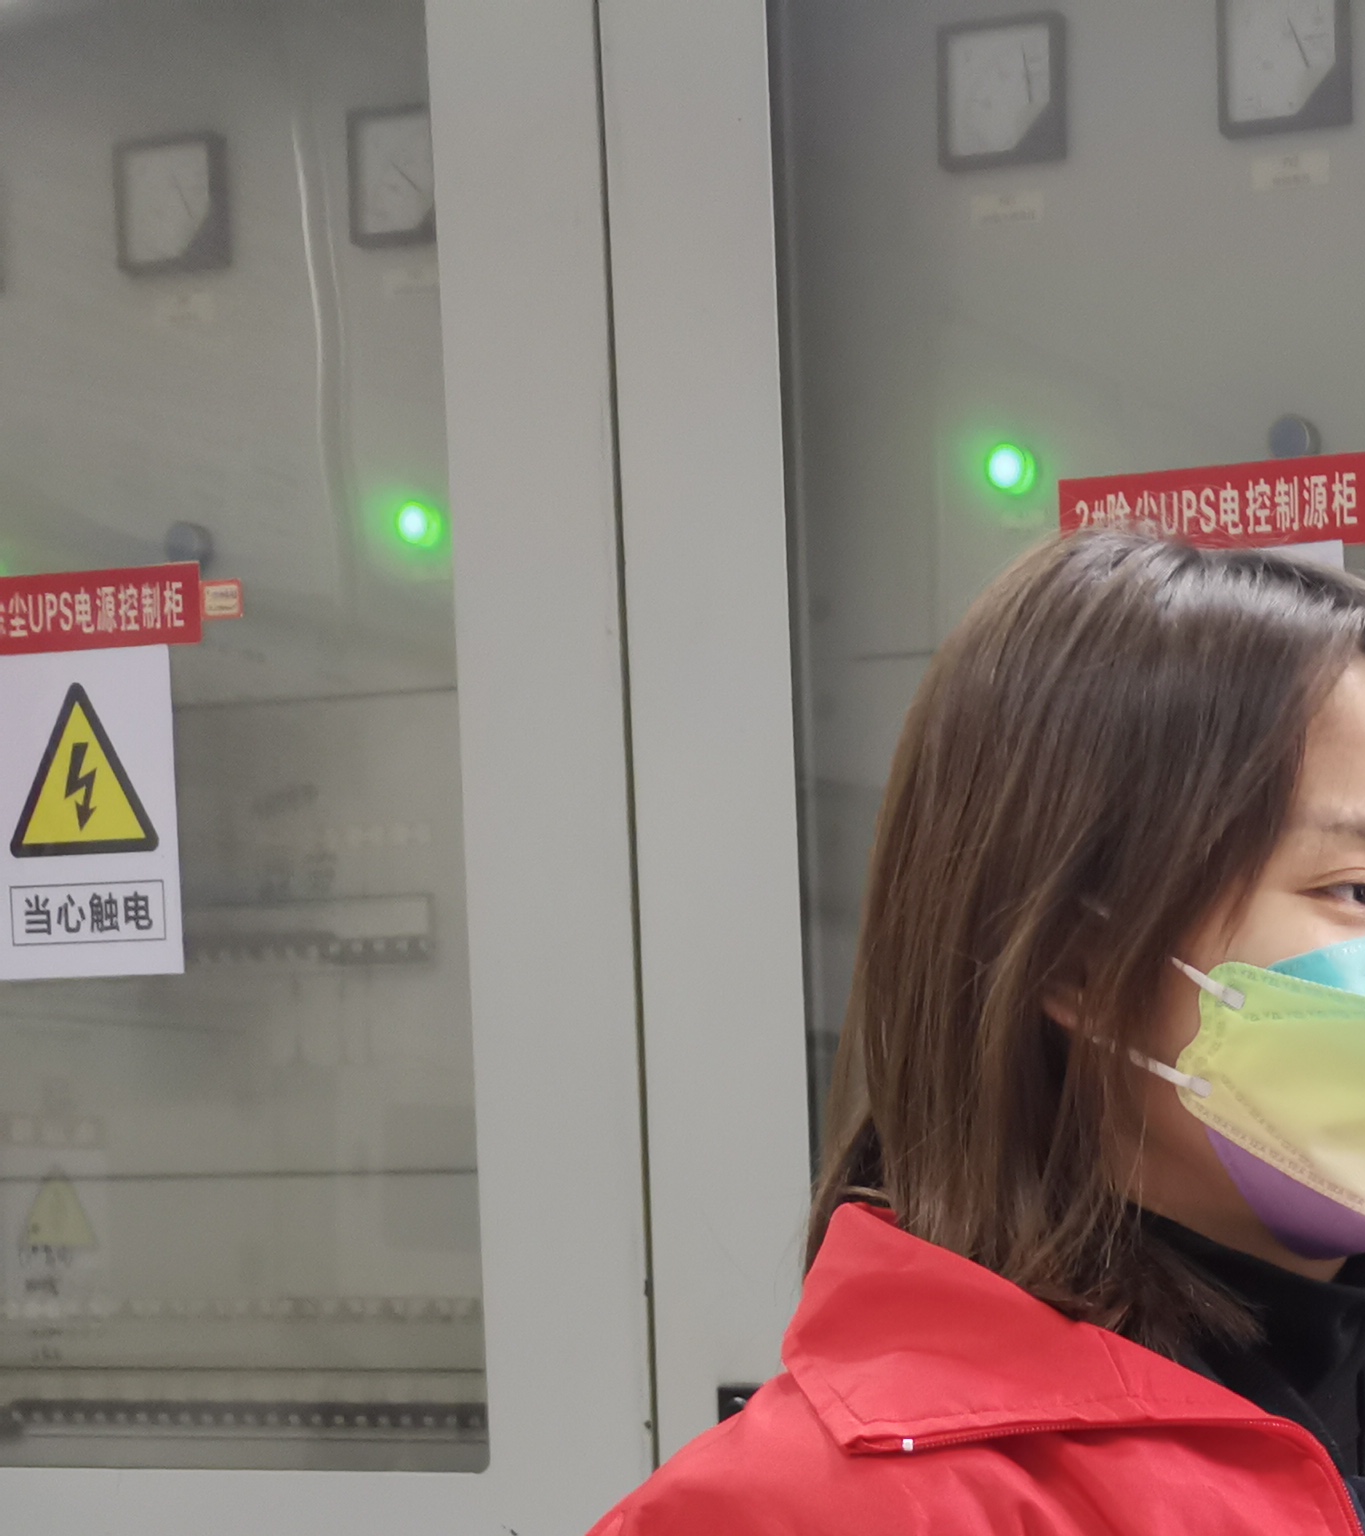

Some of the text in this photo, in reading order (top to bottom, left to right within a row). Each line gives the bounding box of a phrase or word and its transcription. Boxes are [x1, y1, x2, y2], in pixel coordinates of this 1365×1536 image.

[0, 580, 185, 638] 尘UPS电源控制柜
[24, 890, 154, 936] 当心触电
